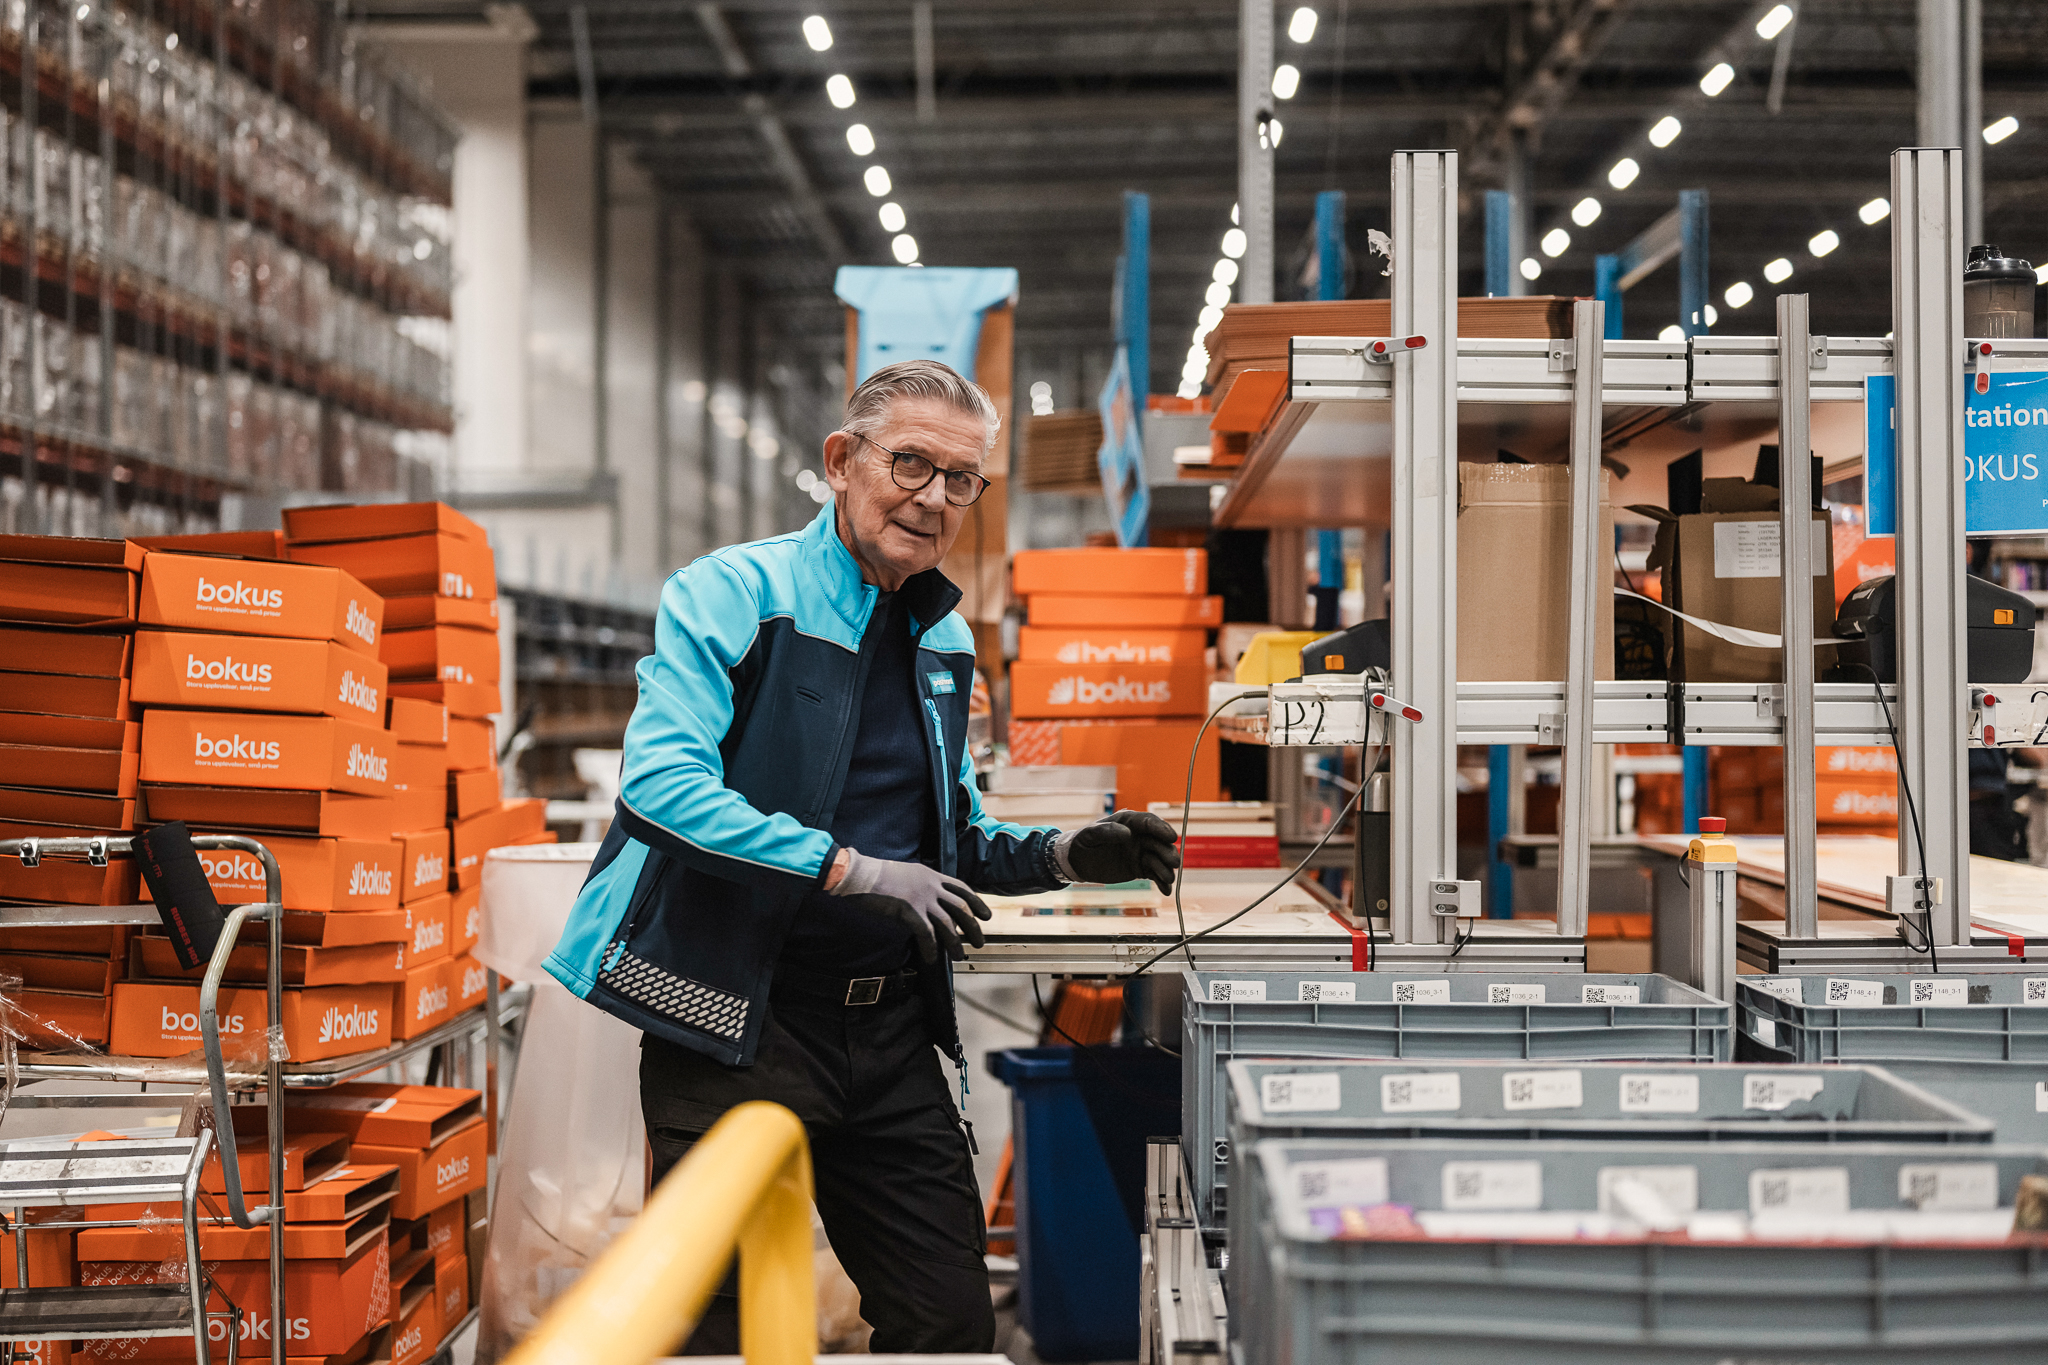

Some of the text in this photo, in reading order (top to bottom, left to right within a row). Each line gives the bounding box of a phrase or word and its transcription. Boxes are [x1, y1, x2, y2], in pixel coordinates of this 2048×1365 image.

[1965, 403, 2048, 427] tation
[1965, 454, 2039, 482] KUS
[197, 577, 283, 608] bokus
[352, 601, 376, 645] bokus
[187, 654, 272, 683] bokus
[348, 671, 377, 713] bokus
[1077, 676, 1171, 704] bokus
[1284, 701, 1325, 745] P2
[195, 732, 280, 761] bokus
[356, 743, 388, 782] bokus
[198, 853, 266, 881] boku
[359, 861, 392, 895] bokus
[170, 906, 200, 966] RUBBER HOS
[162, 1006, 244, 1034] bous
[334, 1004, 378, 1040] bokus
[437, 1156, 469, 1186] bokus
[396, 1327, 421, 1358] bokus
